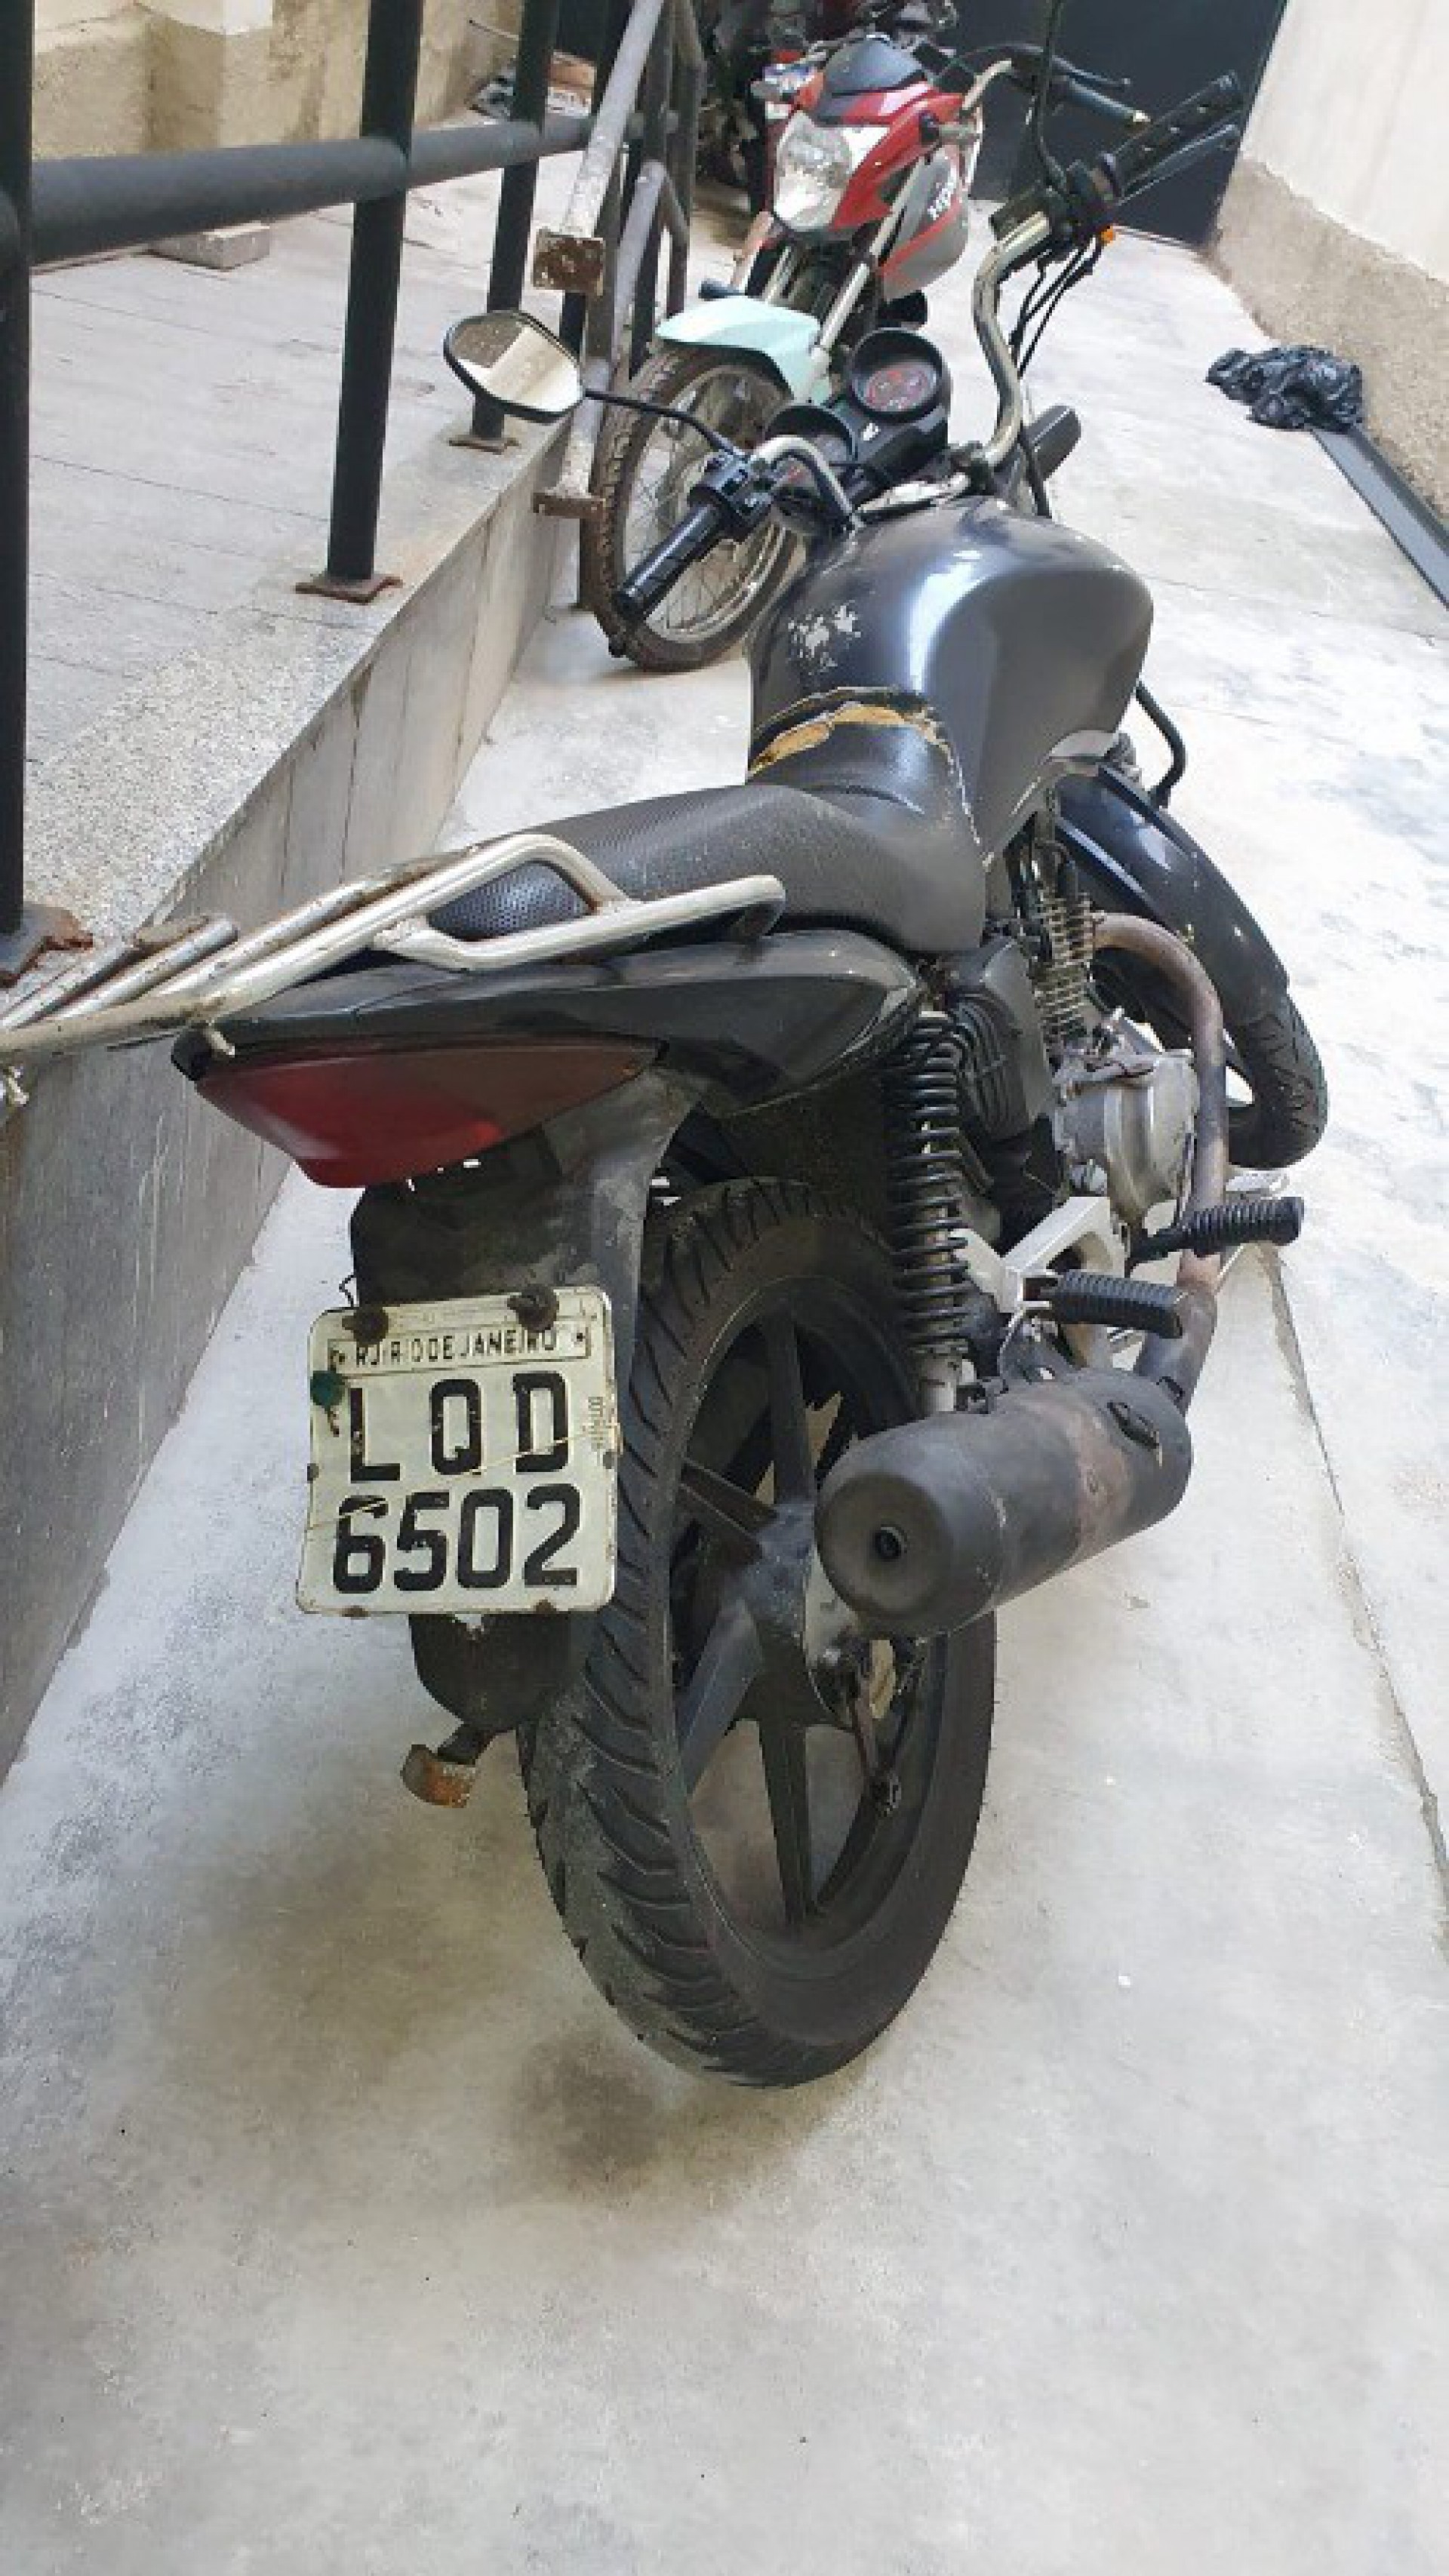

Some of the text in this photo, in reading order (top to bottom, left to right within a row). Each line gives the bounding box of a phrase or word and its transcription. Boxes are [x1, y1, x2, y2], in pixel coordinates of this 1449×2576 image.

[429, 1335, 454, 1361] DE
[460, 1327, 558, 1358] JANEIRO
[350, 1371, 568, 1483] LQD
[333, 1483, 580, 1594] 6502
